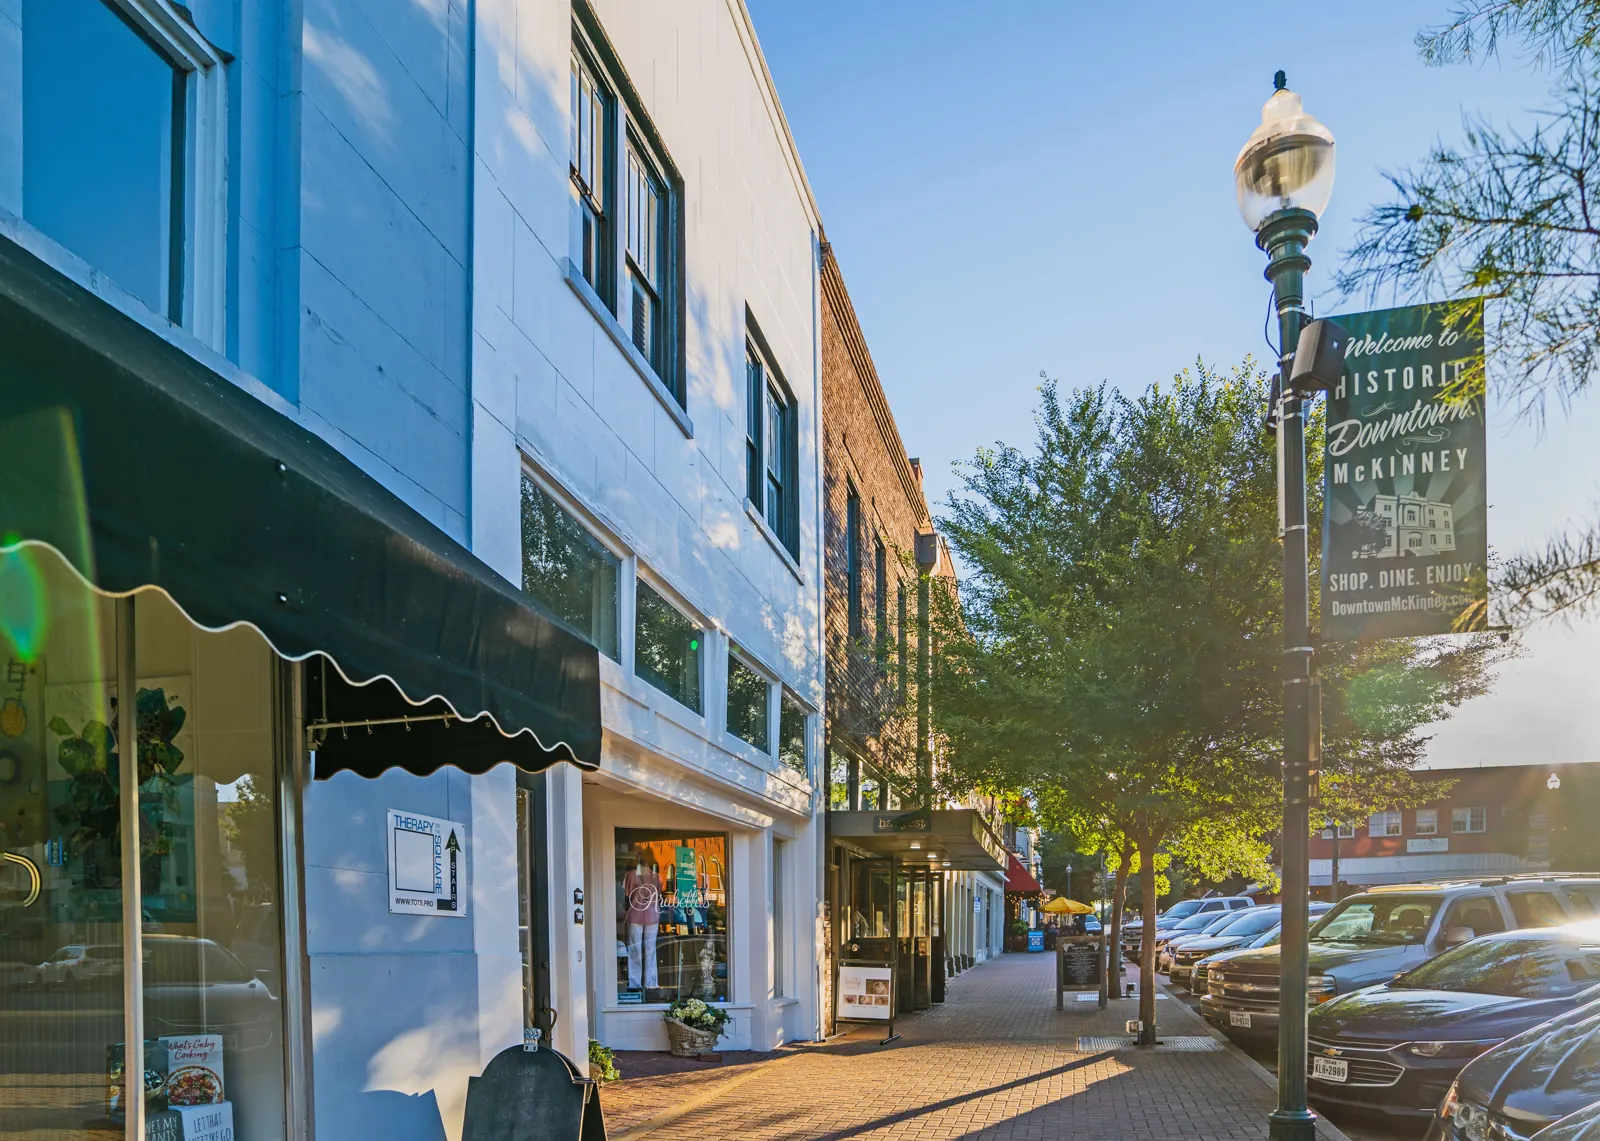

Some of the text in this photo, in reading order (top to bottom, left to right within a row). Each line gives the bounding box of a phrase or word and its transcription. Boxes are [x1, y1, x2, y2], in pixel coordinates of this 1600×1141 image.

[1344, 327, 1459, 359] Welcome to
[1328, 398, 1476, 456] Downtown
[1334, 448, 1468, 484] McKINNEY
[1329, 572, 1374, 592] SHOP.
[1379, 568, 1420, 589] DINE.
[394, 814, 434, 833] THERAPY
[395, 897, 434, 907] WWW.TOTS.PRO
[193, 1038, 215, 1051] Gaby
[175, 1049, 208, 1061] Cooking
[163, 1116, 178, 1130] MY
[194, 1113, 222, 1133] LET THAT
